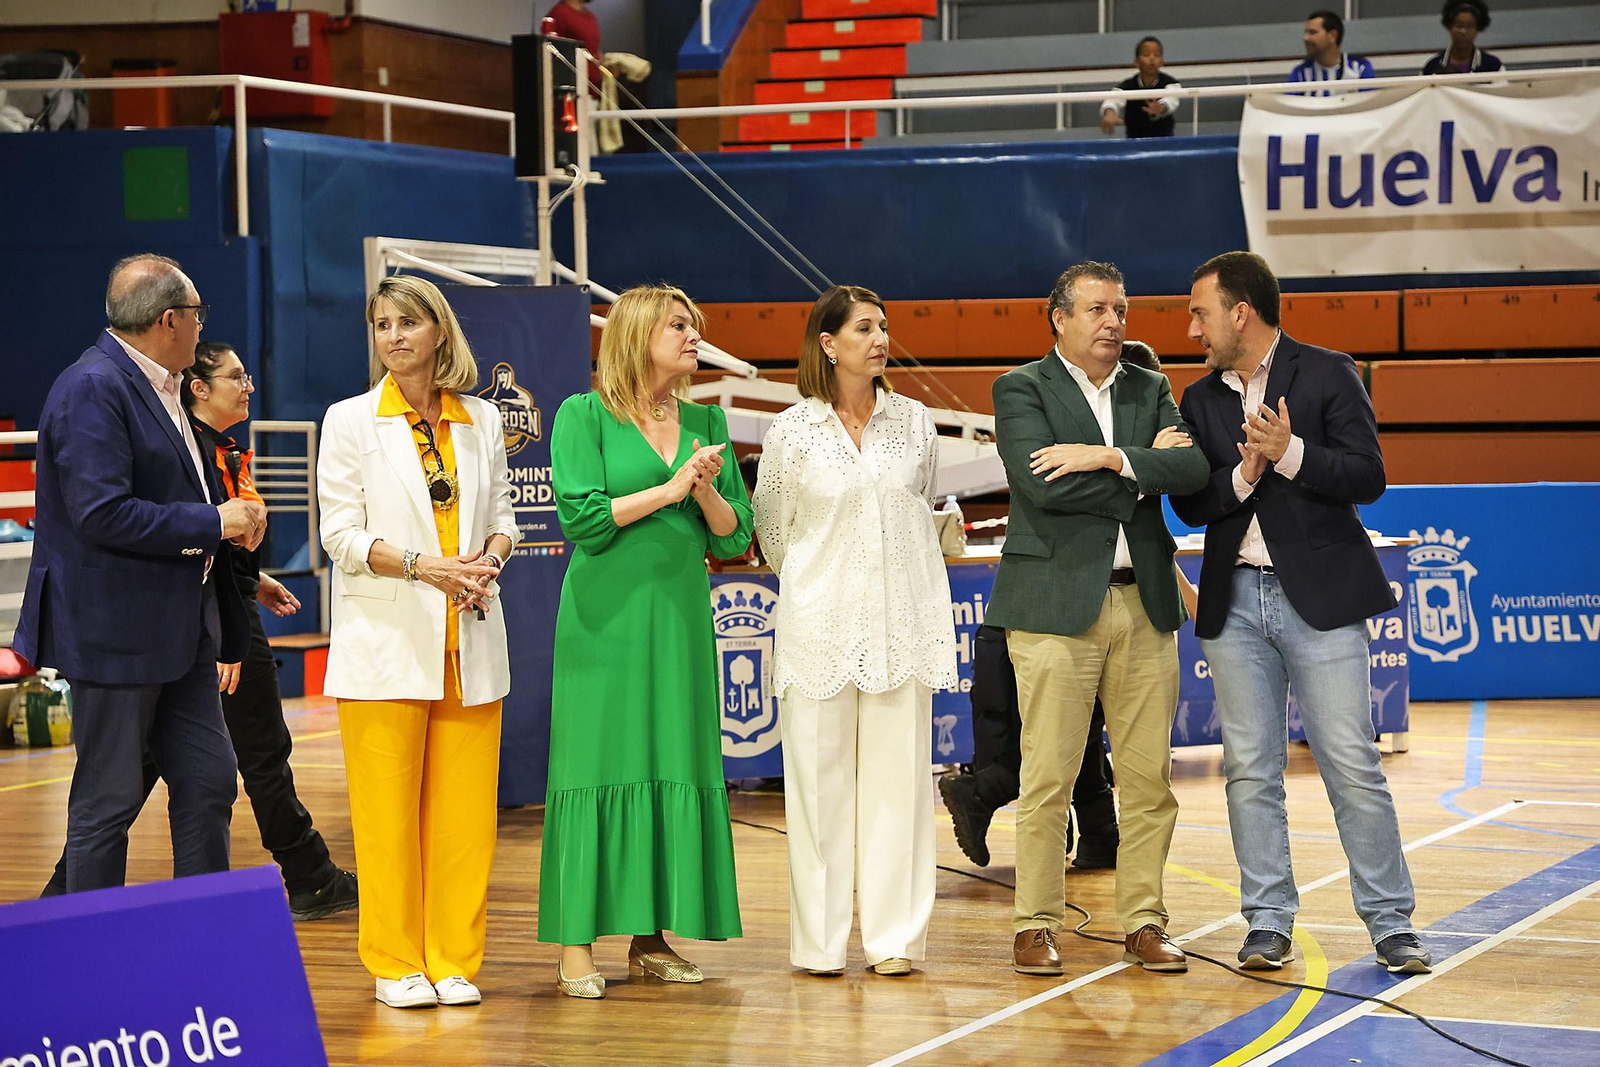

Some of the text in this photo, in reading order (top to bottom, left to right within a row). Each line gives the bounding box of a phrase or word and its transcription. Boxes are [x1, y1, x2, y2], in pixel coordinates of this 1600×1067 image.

[1266, 121, 1561, 210] Huelva
[510, 484, 555, 504] ORD
[1491, 592, 1600, 614] Ayuntamiento
[1492, 614, 1600, 643] HUELV
[1370, 650, 1408, 668] rtes
[182, 1006, 242, 1064] de
